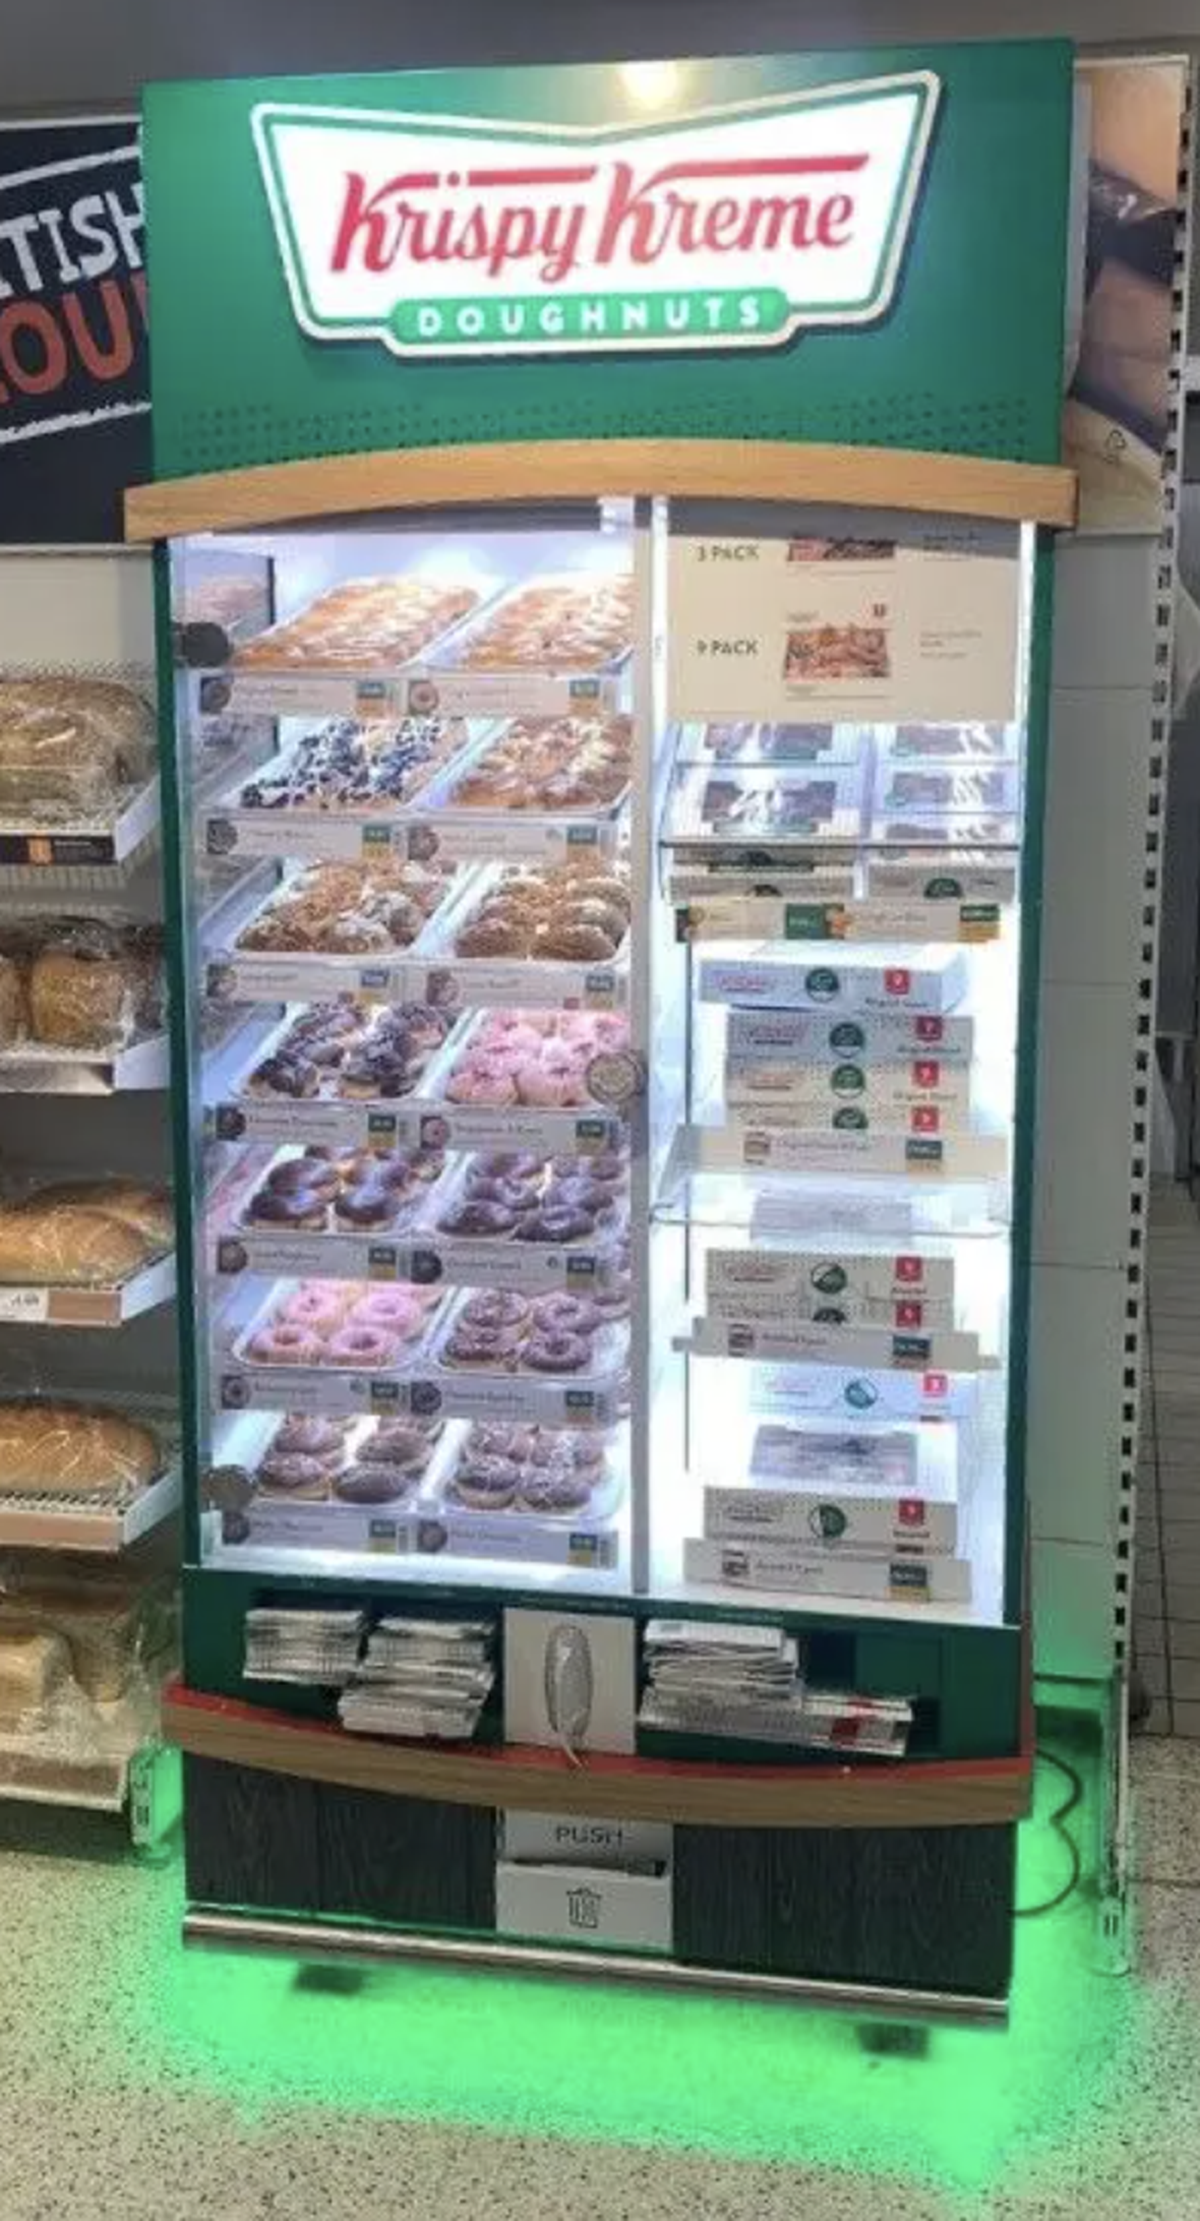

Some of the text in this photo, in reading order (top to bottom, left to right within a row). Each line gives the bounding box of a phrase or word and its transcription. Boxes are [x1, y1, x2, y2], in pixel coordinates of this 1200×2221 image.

[330, 152, 871, 283] Krispy Kreme
[0, 183, 146, 298] TISH
[0, 270, 148, 402] OU
[415, 295, 761, 338] DOUGHNUTS
[711, 545, 760, 562] PACK
[711, 639, 759, 656] PACK
[556, 1825, 623, 1846] PUSH
